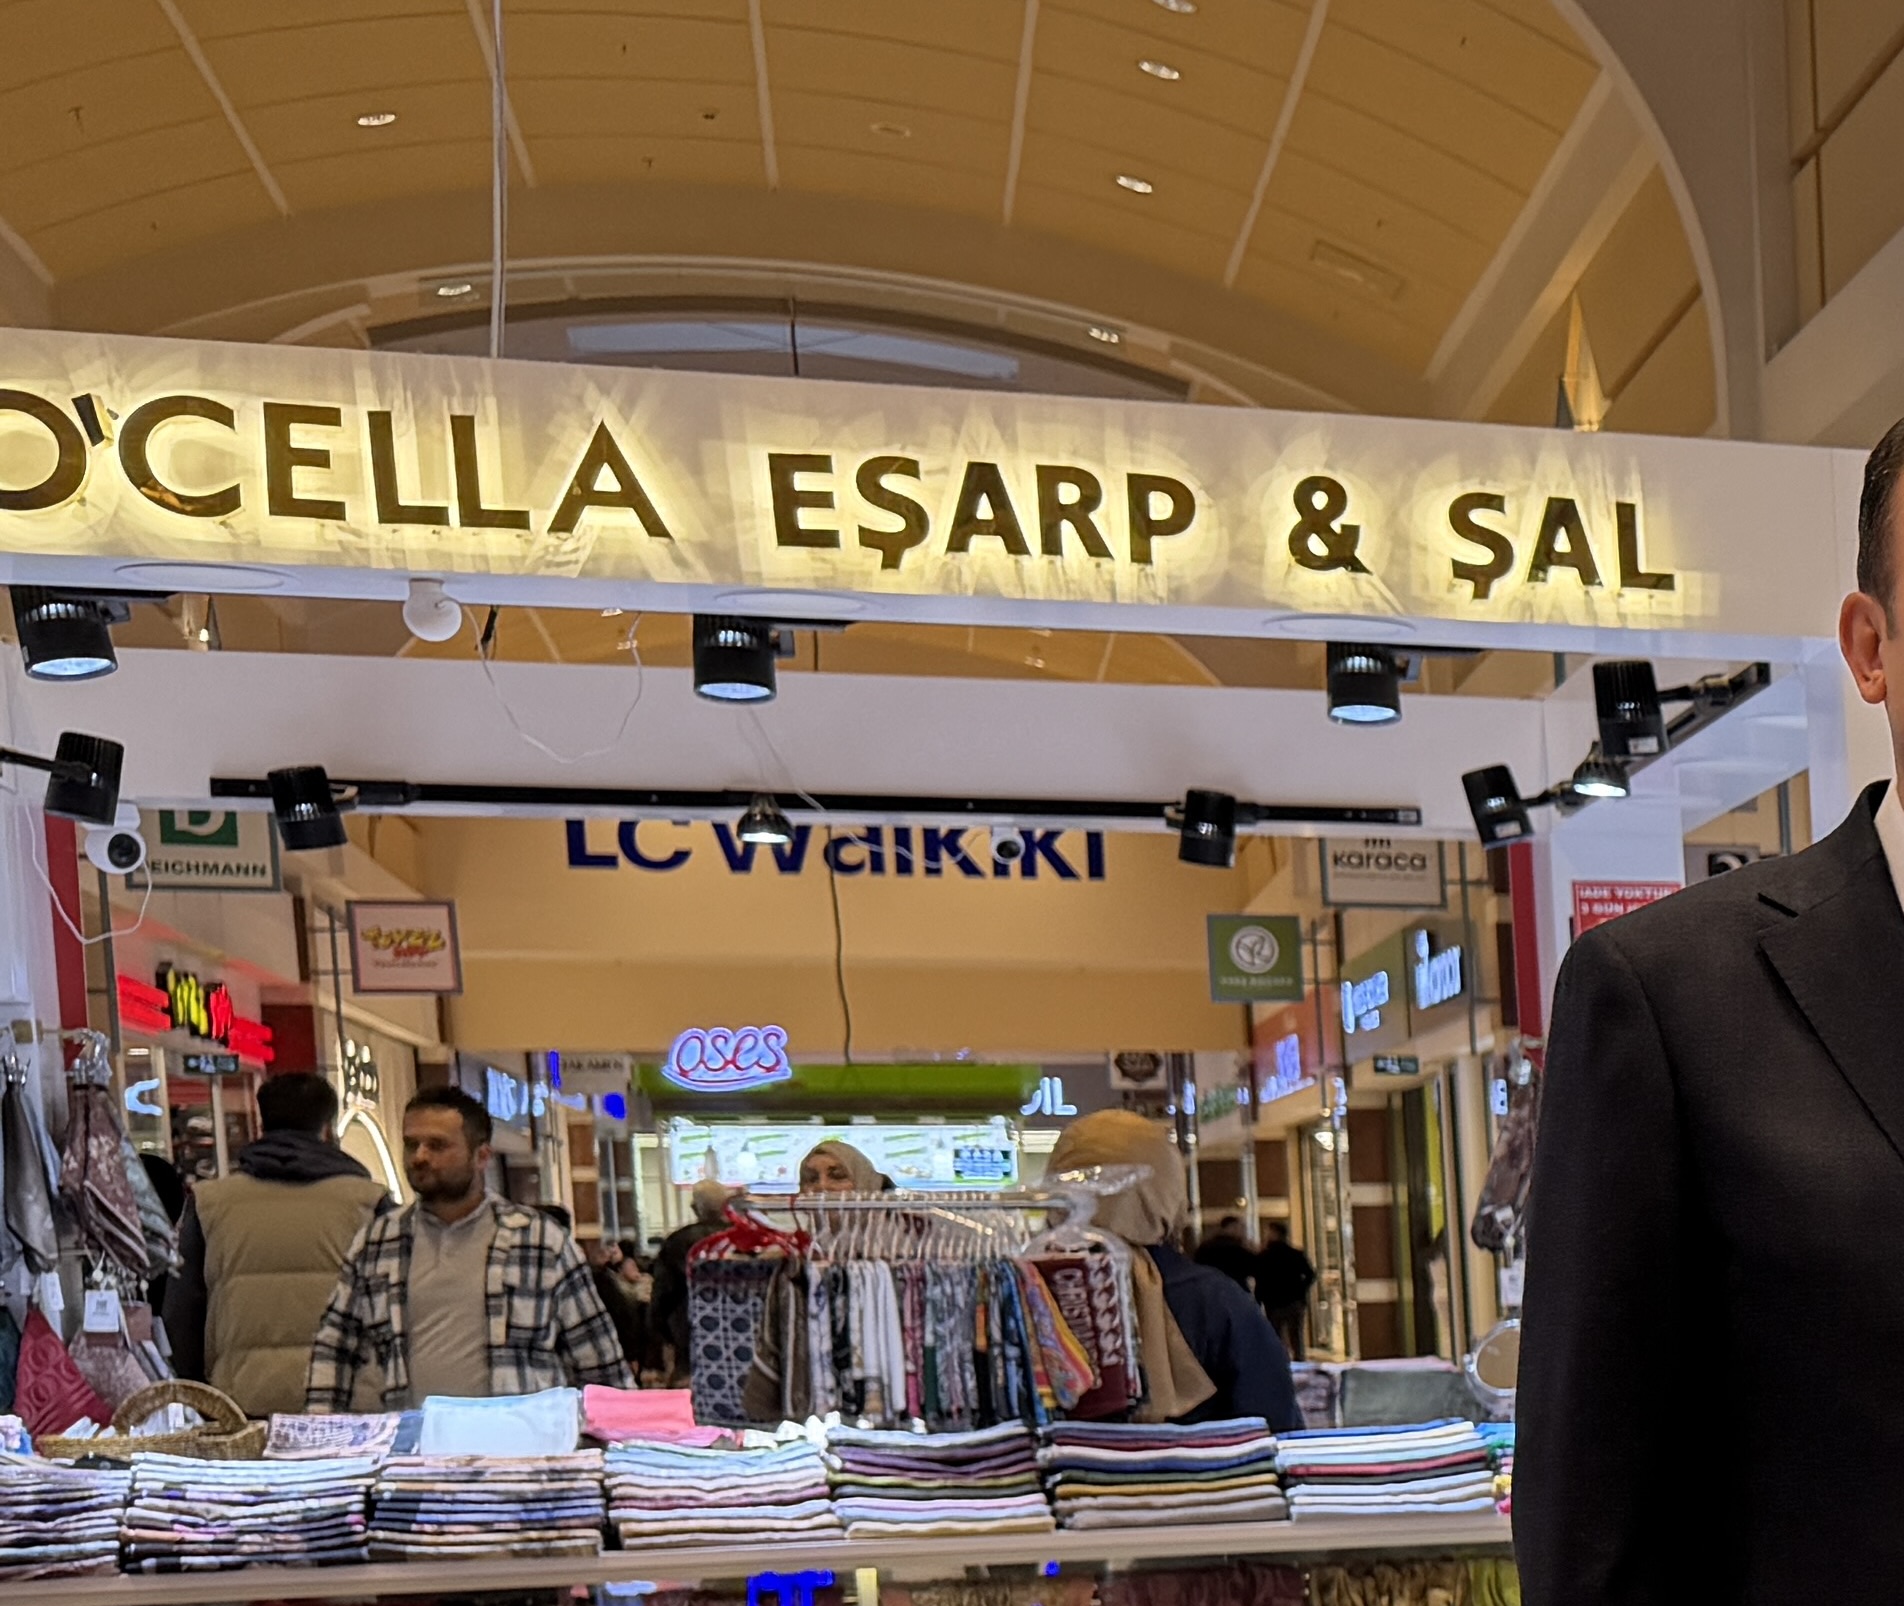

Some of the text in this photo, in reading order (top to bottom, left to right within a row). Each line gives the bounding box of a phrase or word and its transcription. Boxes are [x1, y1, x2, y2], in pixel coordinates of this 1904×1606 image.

[767, 452, 1197, 571] EŞARP
[1287, 475, 1373, 574] &
[1448, 491, 1676, 599] ŞAL
[148, 857, 267, 878] EICHMANN
[1333, 850, 1427, 871] karaca
